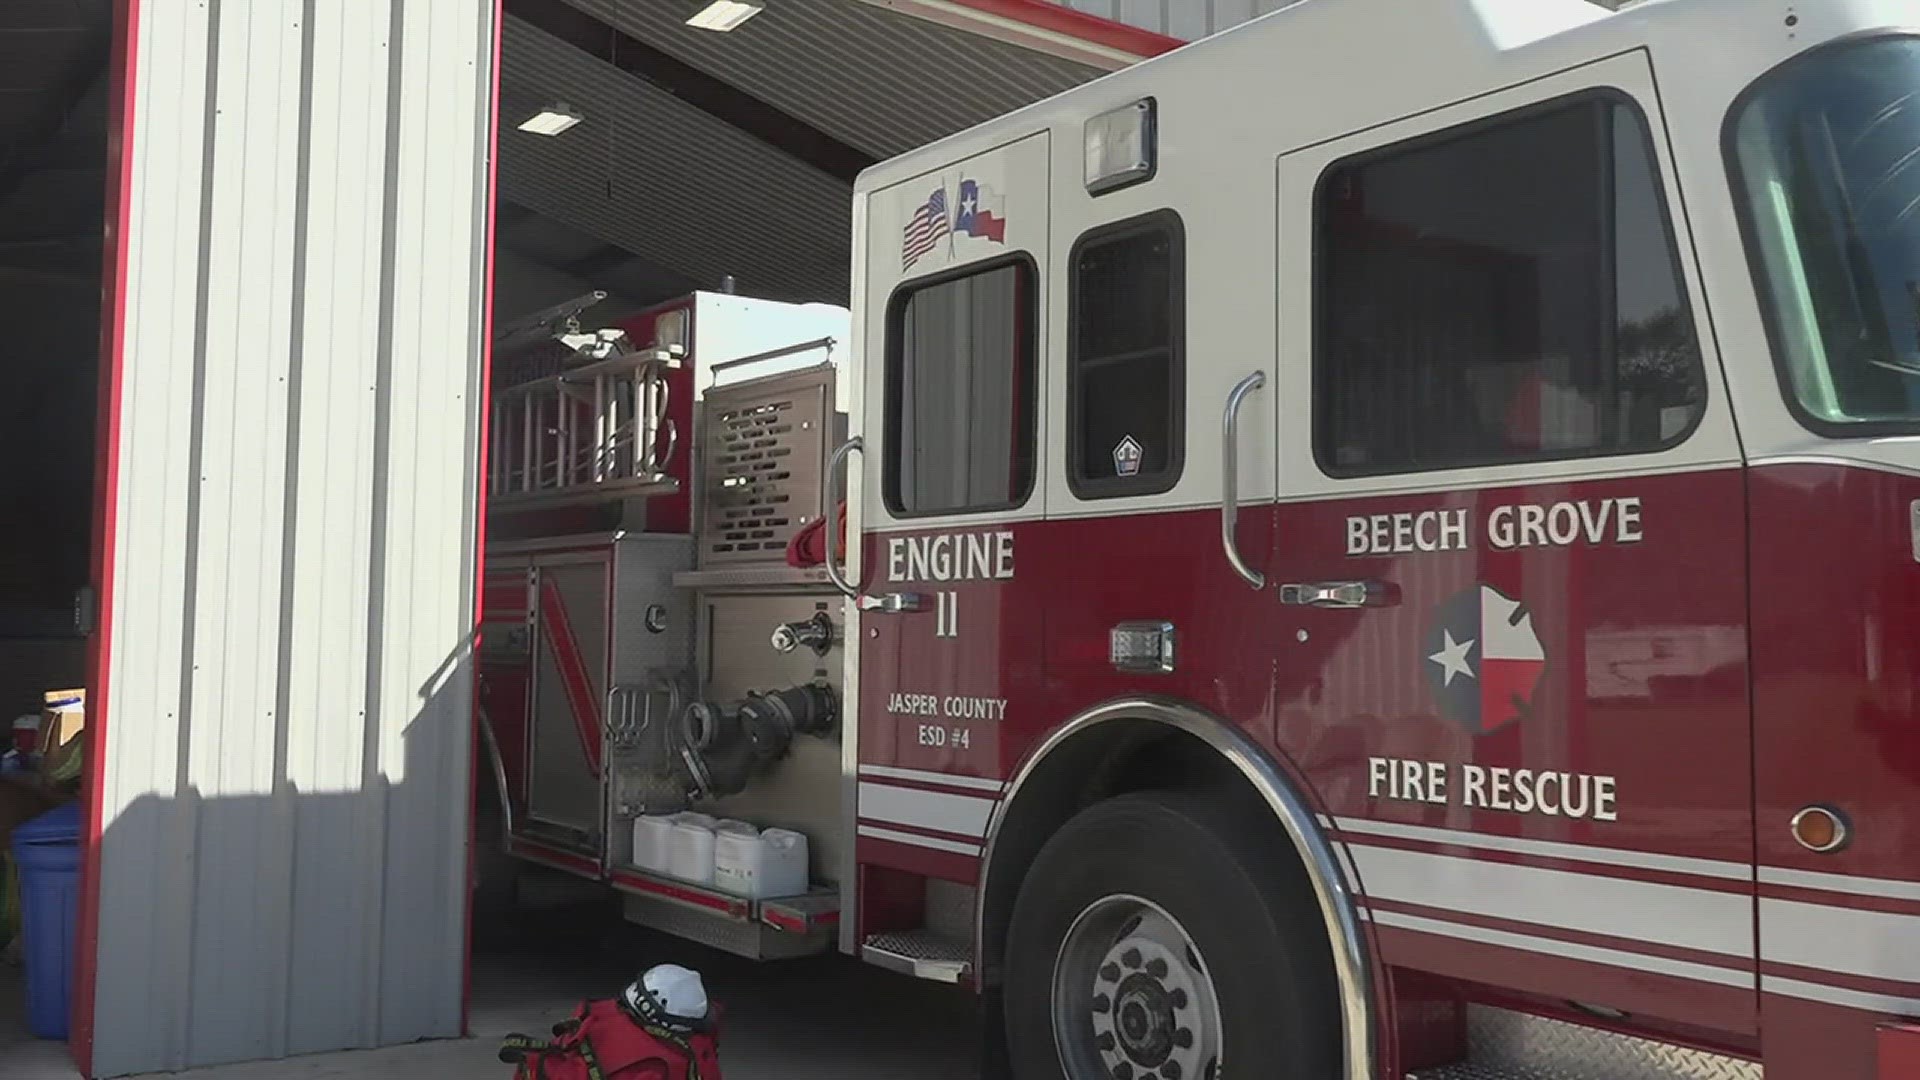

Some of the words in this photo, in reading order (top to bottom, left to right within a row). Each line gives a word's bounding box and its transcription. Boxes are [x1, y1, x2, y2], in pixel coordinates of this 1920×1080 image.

[1346, 509, 1468, 555] BEECH
[1488, 497, 1643, 548] GROVE
[888, 531, 1015, 582] ENGINE
[887, 693, 938, 715] JASPER
[944, 697, 1008, 720] COUNTY
[918, 725, 946, 746] ESD
[951, 728, 970, 749] #4
[1368, 757, 1447, 804] FIRE
[1463, 765, 1618, 821] RESCUE
